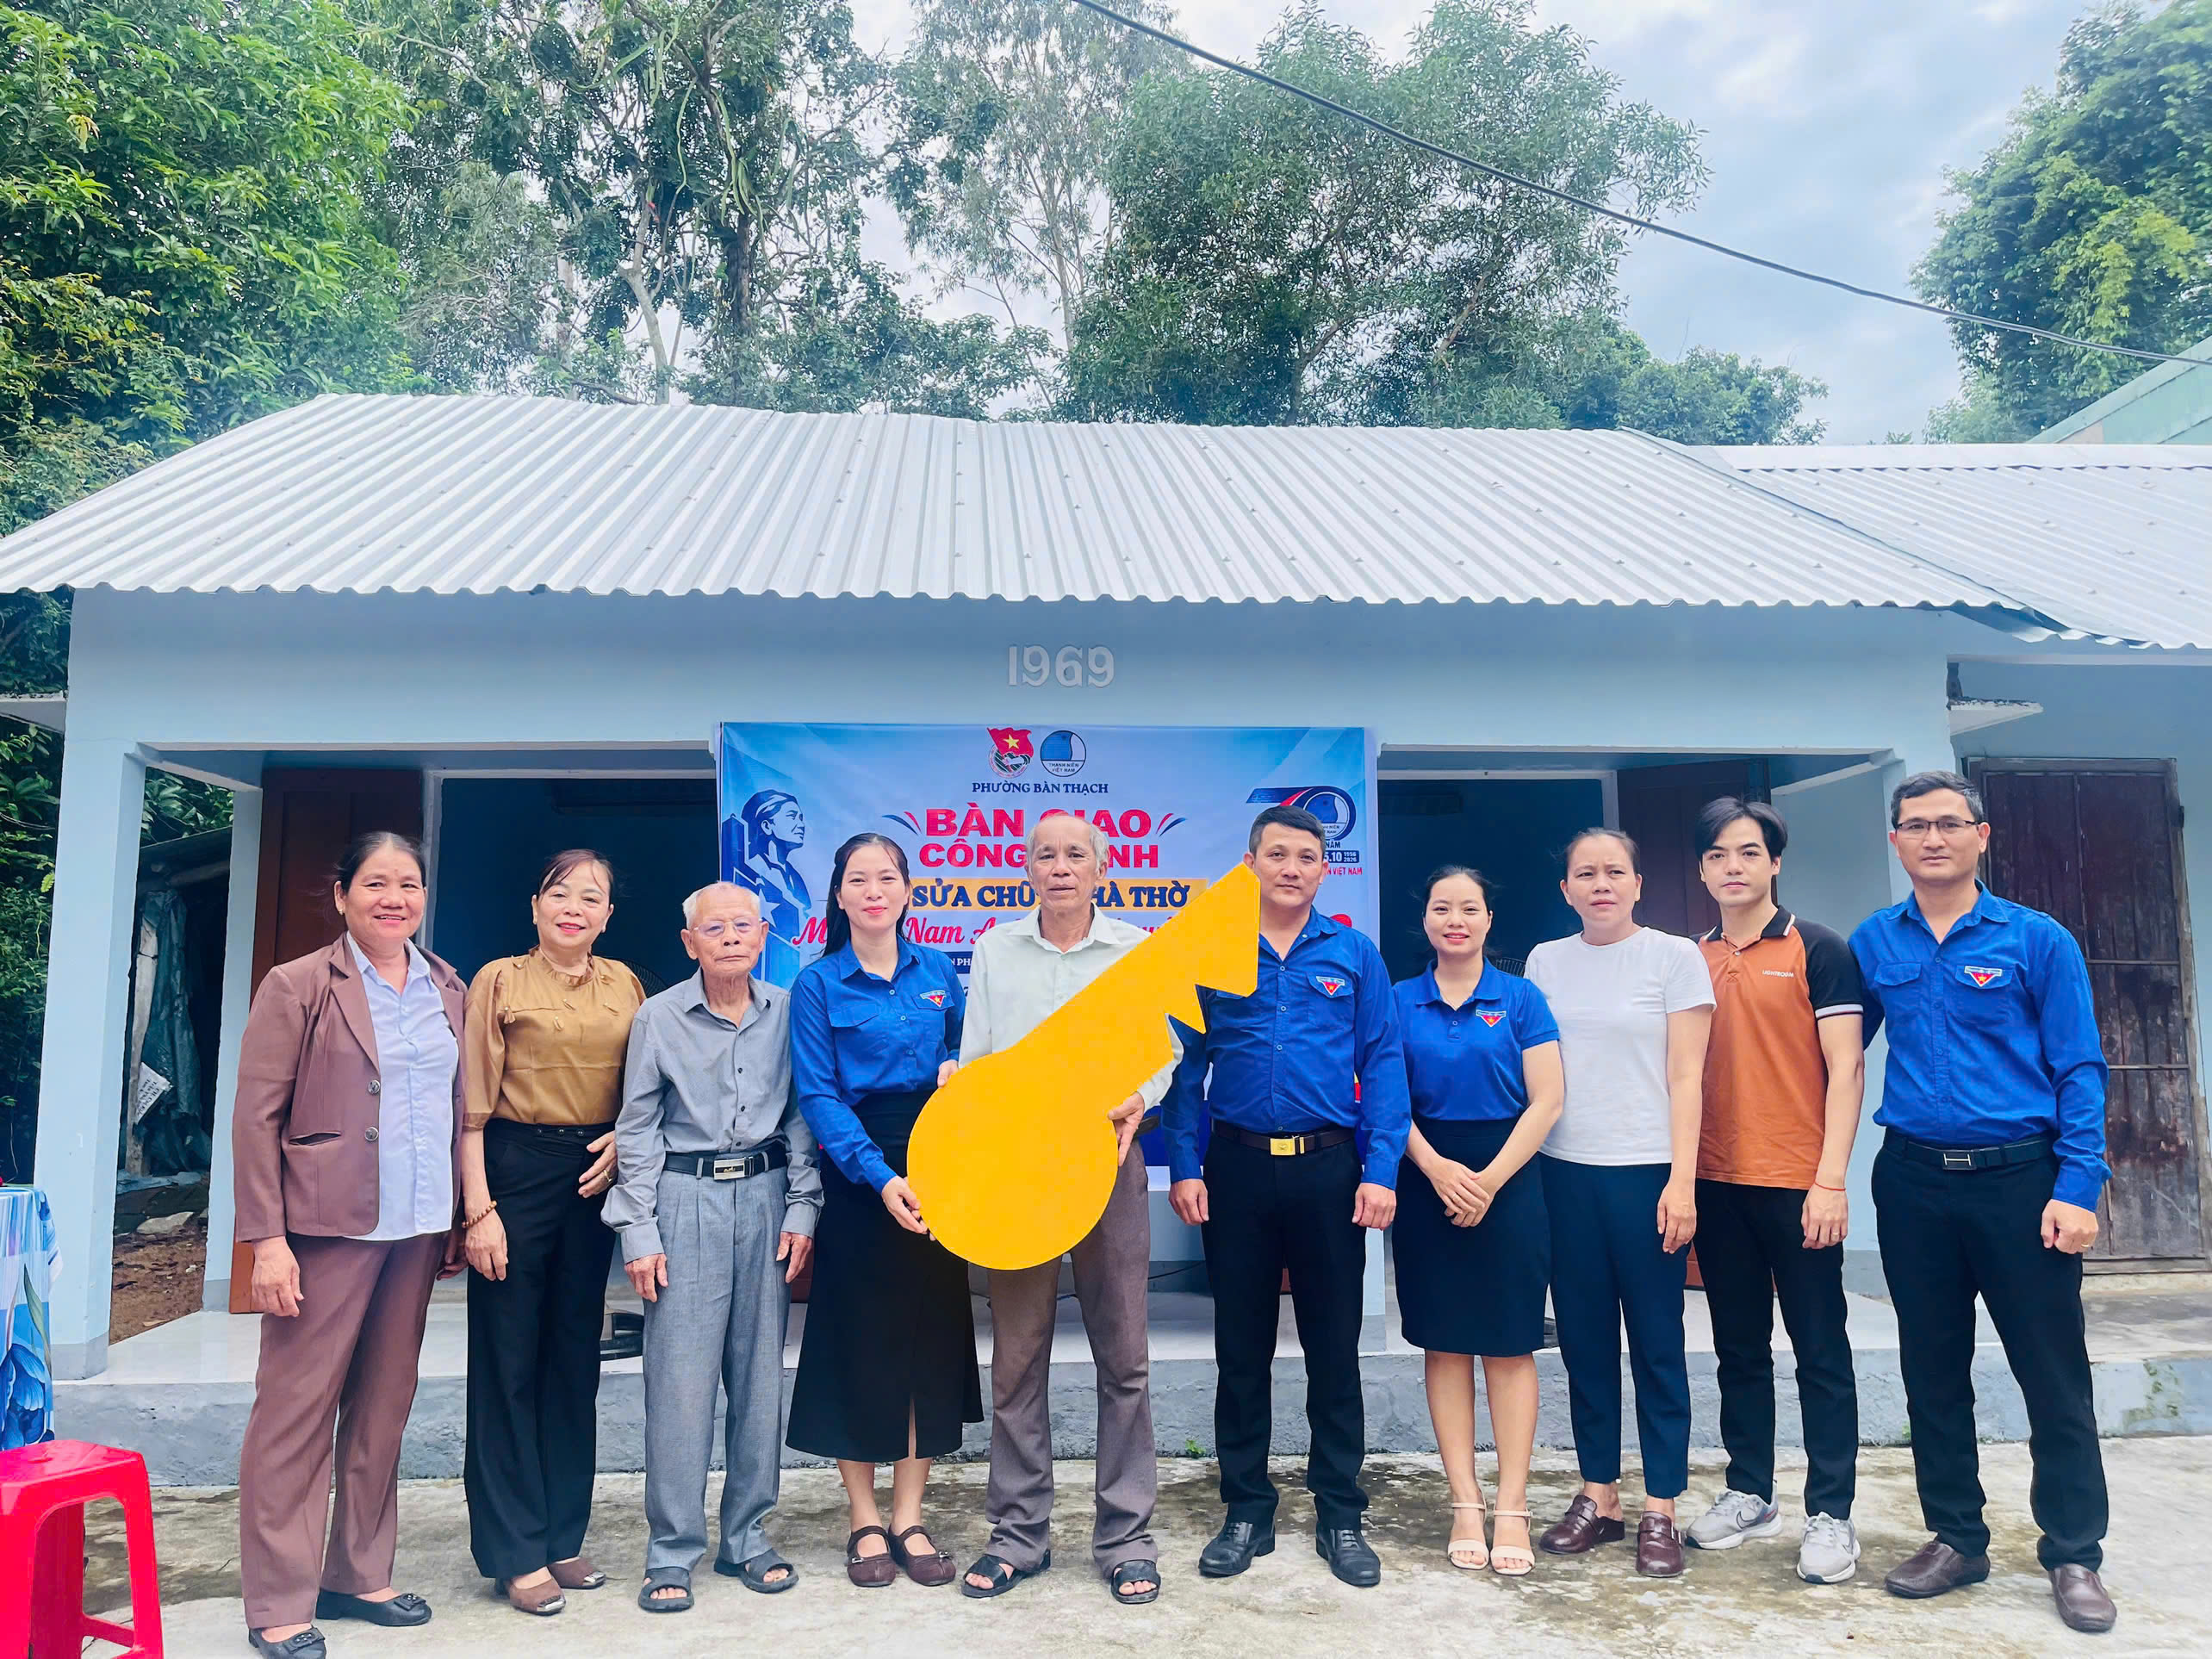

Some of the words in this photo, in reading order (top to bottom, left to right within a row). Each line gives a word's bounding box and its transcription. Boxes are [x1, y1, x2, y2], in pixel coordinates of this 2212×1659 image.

[1008, 645, 1115, 687] 1969
[972, 780, 1030, 793] PHƯỜNG
[1034, 780, 1060, 793] BÀN
[1063, 783, 1109, 796] THẠCH
[926, 802, 1024, 837] BÀN
[1040, 808, 1152, 838] AO
[919, 838, 1028, 868] CÔNG
[1348, 867, 1363, 876] NAM
[912, 879, 972, 908] SỬA
[1128, 880, 1190, 908] THỜ
[905, 916, 966, 944] Nam
